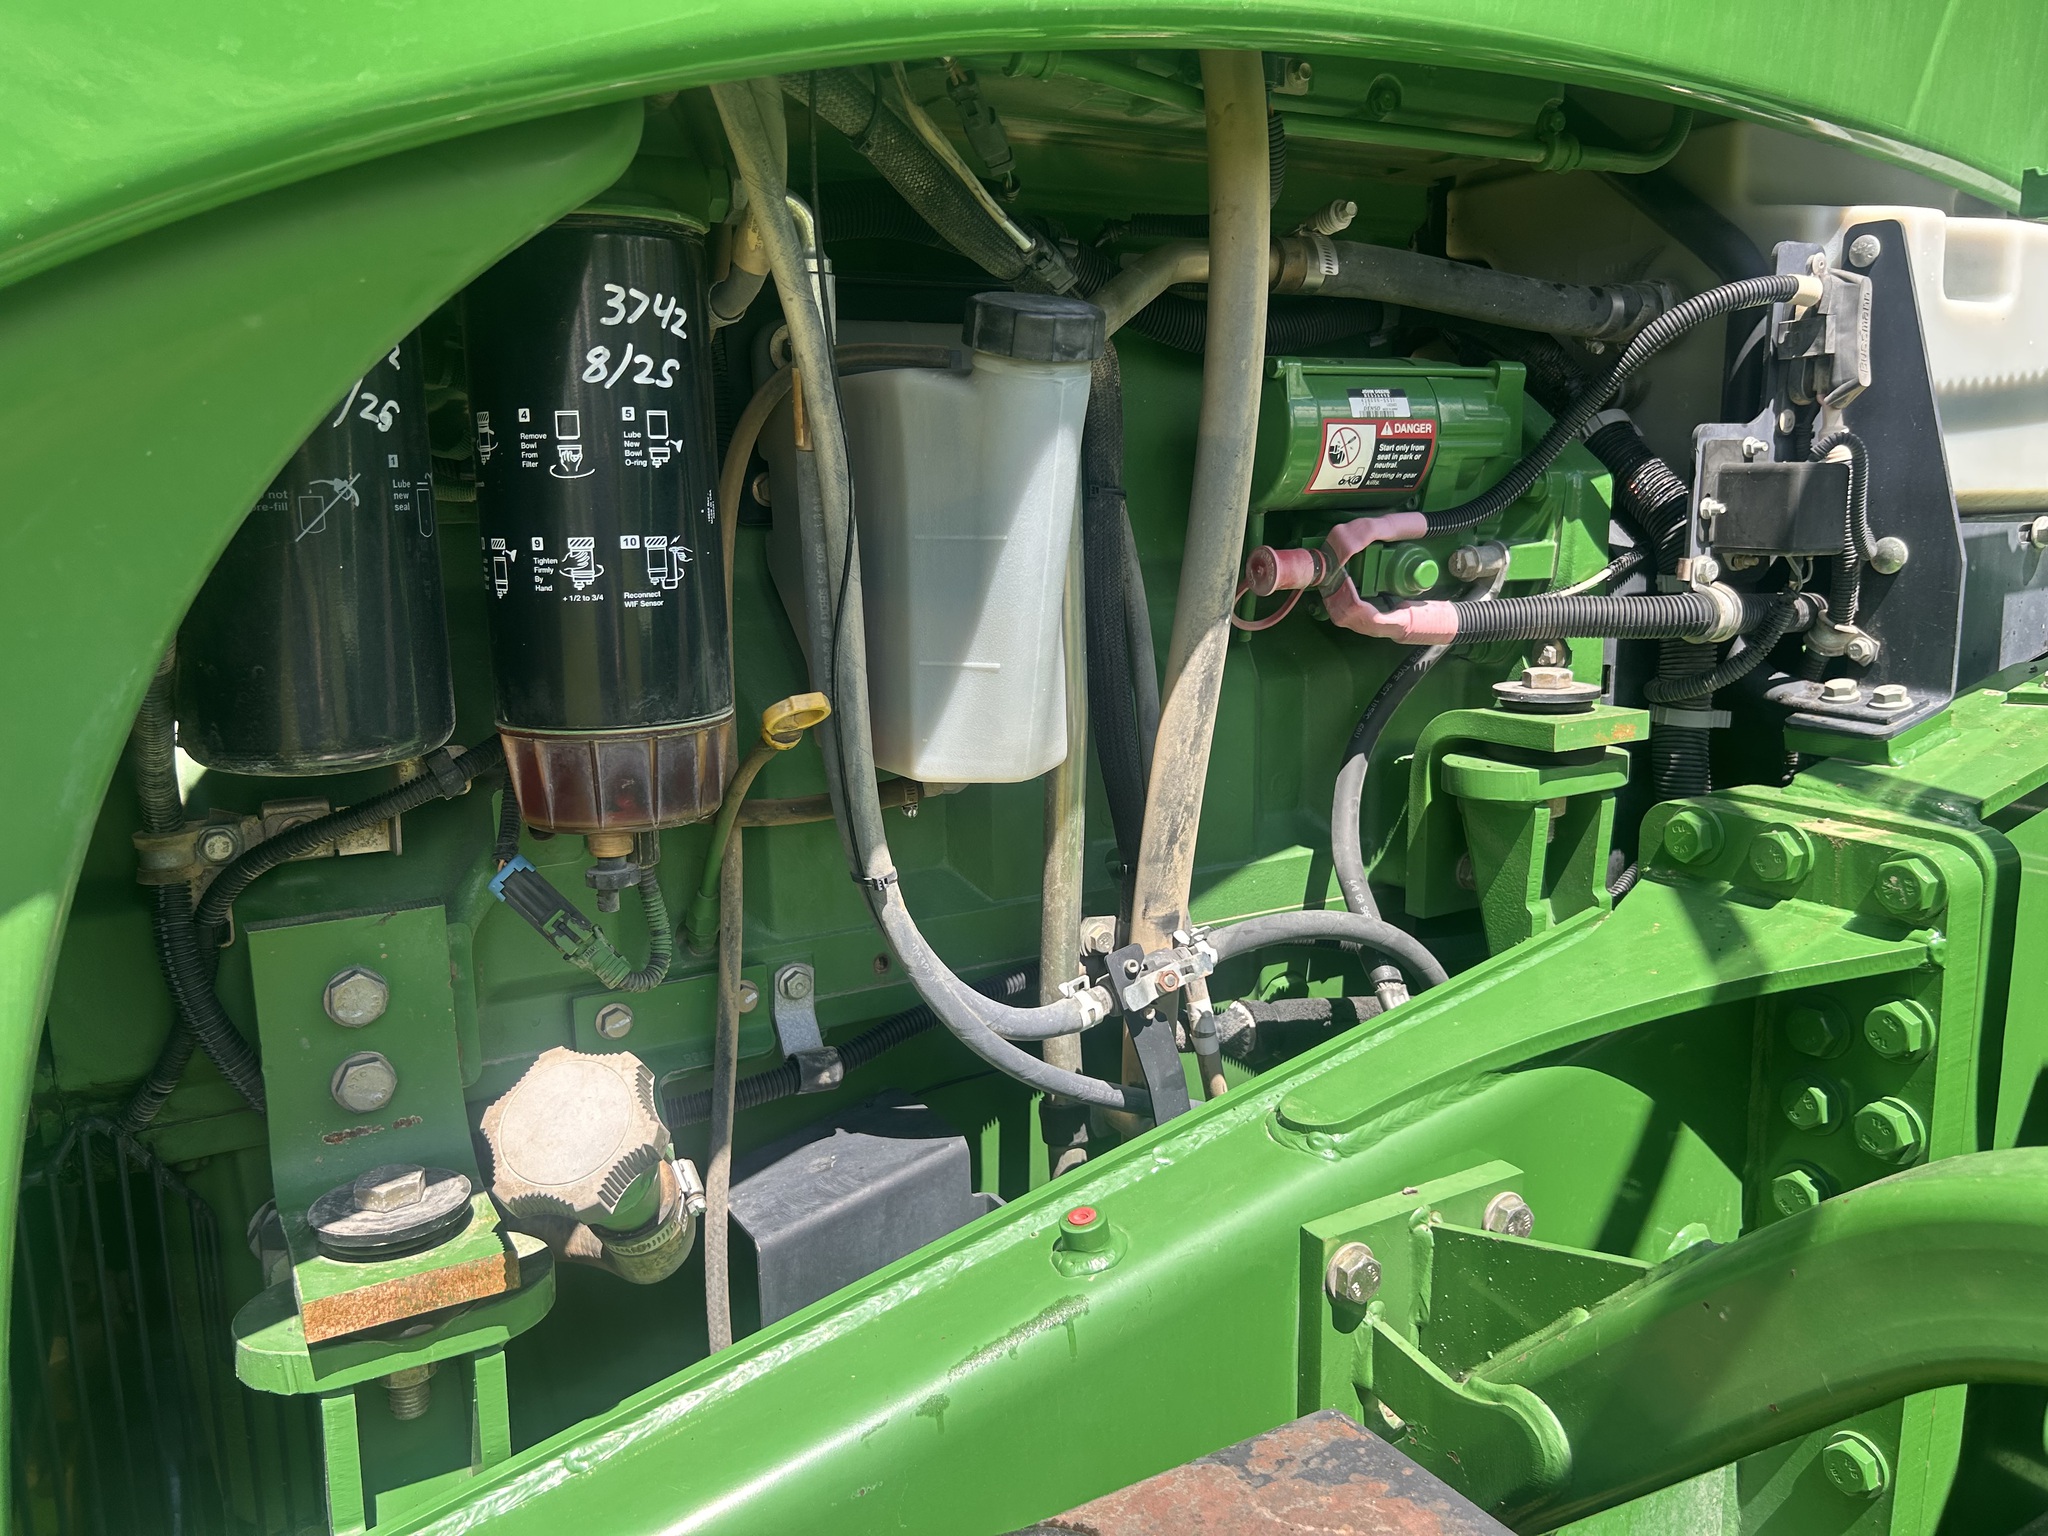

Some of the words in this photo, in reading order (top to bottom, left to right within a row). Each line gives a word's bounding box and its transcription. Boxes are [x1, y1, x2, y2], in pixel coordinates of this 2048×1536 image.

[600, 283, 687, 340] 3742
[582, 343, 681, 389] 8/25
[1394, 423, 1432, 434] DANGER
[1379, 443, 1395, 452] Start
[1395, 444, 1410, 453] only
[1410, 443, 1425, 451] from
[521, 451, 538, 459] From
[1398, 453, 1413, 461] park
[522, 460, 539, 468] Filter
[625, 459, 648, 467] O-ring
[1374, 461, 1398, 469] neutral.
[1369, 472, 1395, 480] Starting
[392, 479, 411, 488] Lube
[268, 490, 288, 499] not
[393, 492, 409, 500] new
[394, 502, 410, 511] seal
[622, 537, 638, 548] 10
[533, 557, 558, 566] Tighten
[533, 566, 554, 575] Firmly
[534, 576, 544, 584] By
[623, 591, 661, 599] Reconnect
[1392, 664, 1410, 682] TYPE
